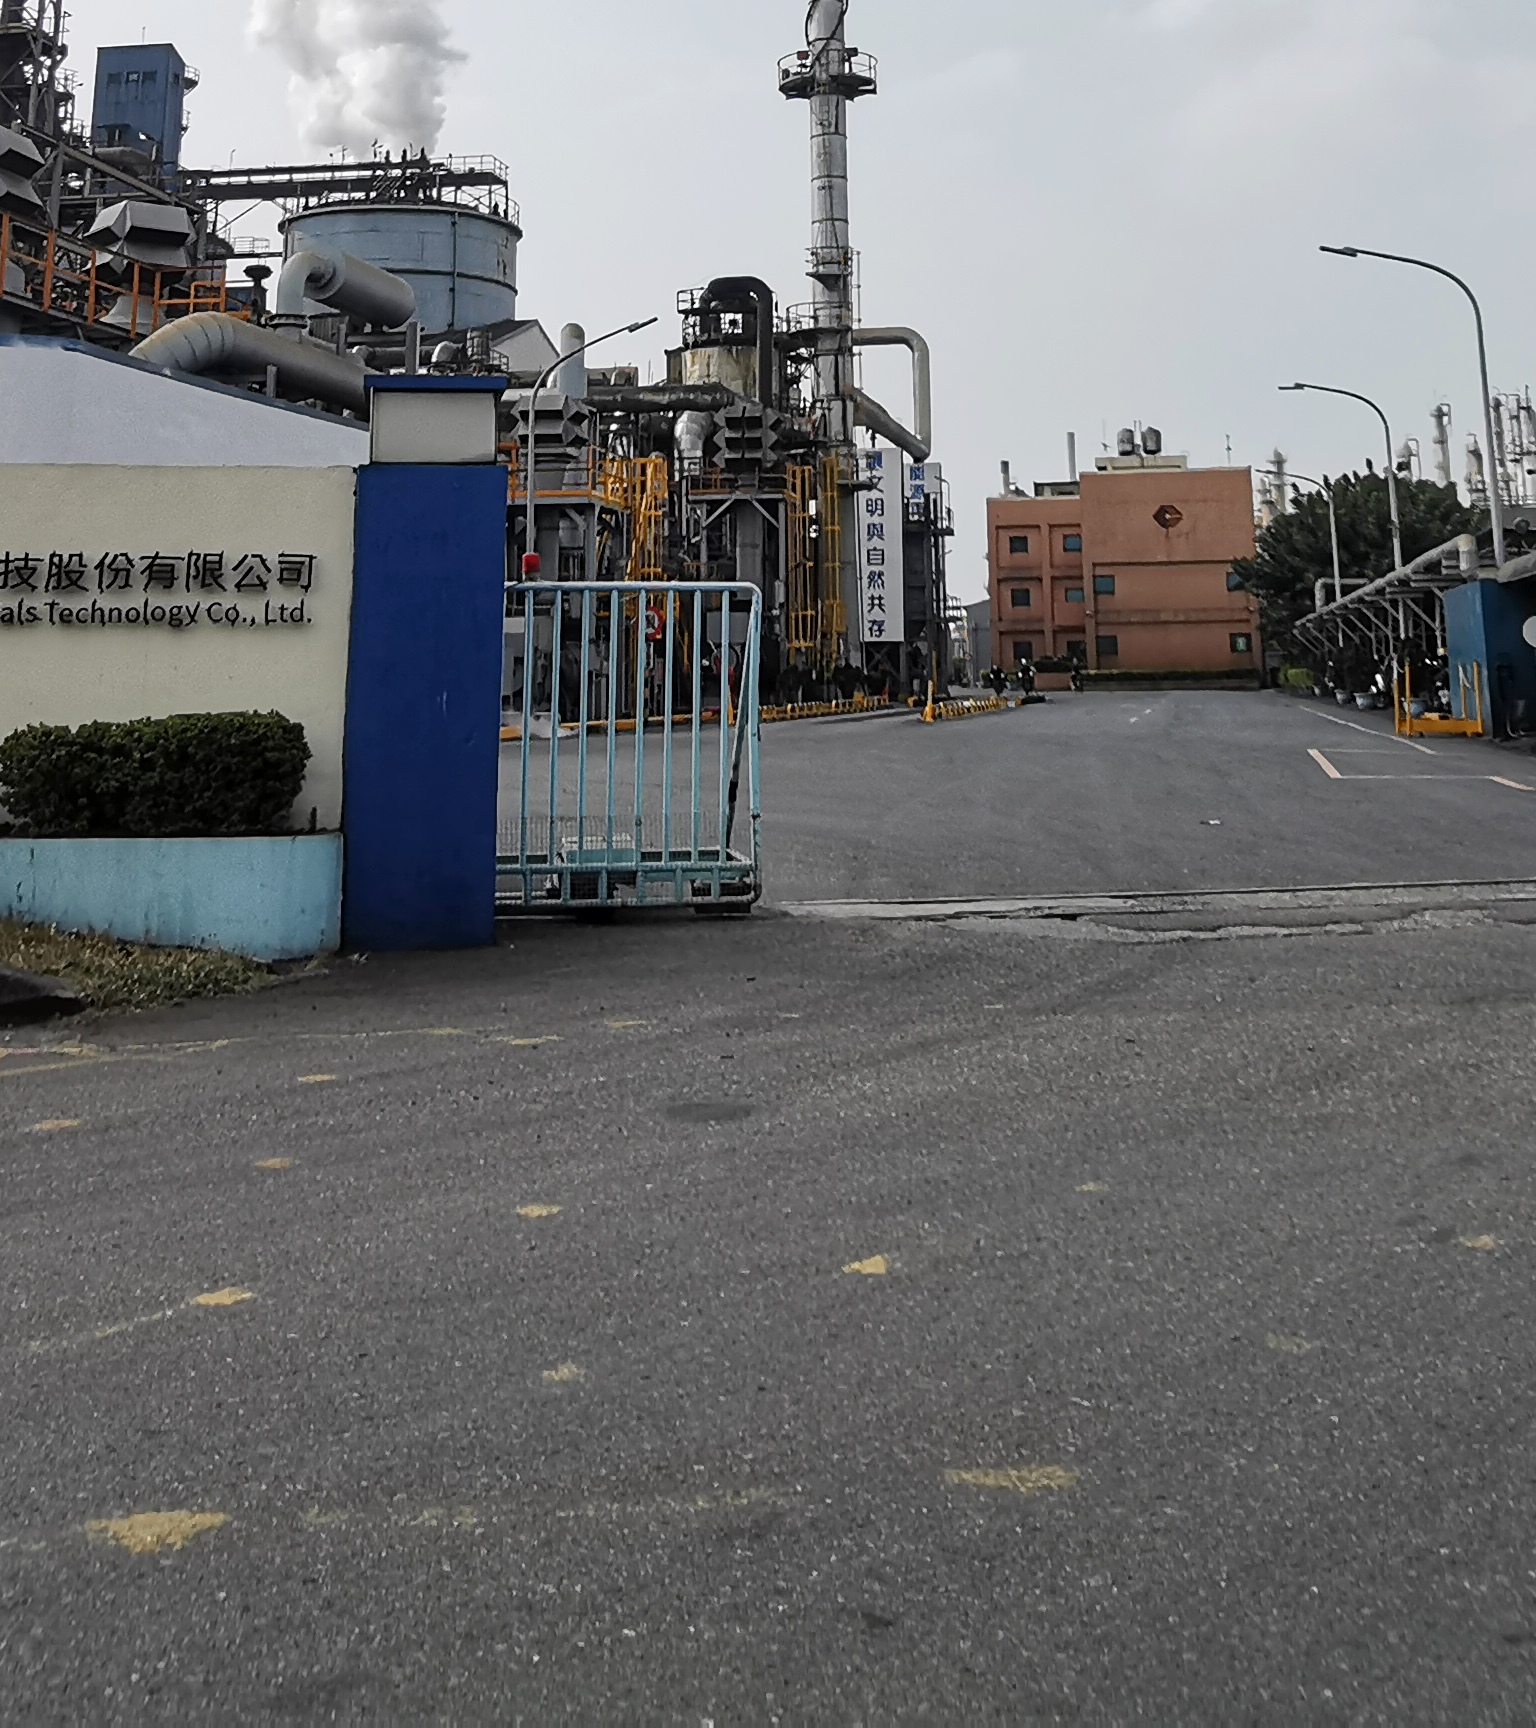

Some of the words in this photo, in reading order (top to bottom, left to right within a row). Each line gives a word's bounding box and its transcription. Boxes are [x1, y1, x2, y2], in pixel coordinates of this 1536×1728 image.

[44, 597, 200, 629] Technology
[206, 601, 256, 628] Co.,
[265, 598, 312, 626] Ltd.
